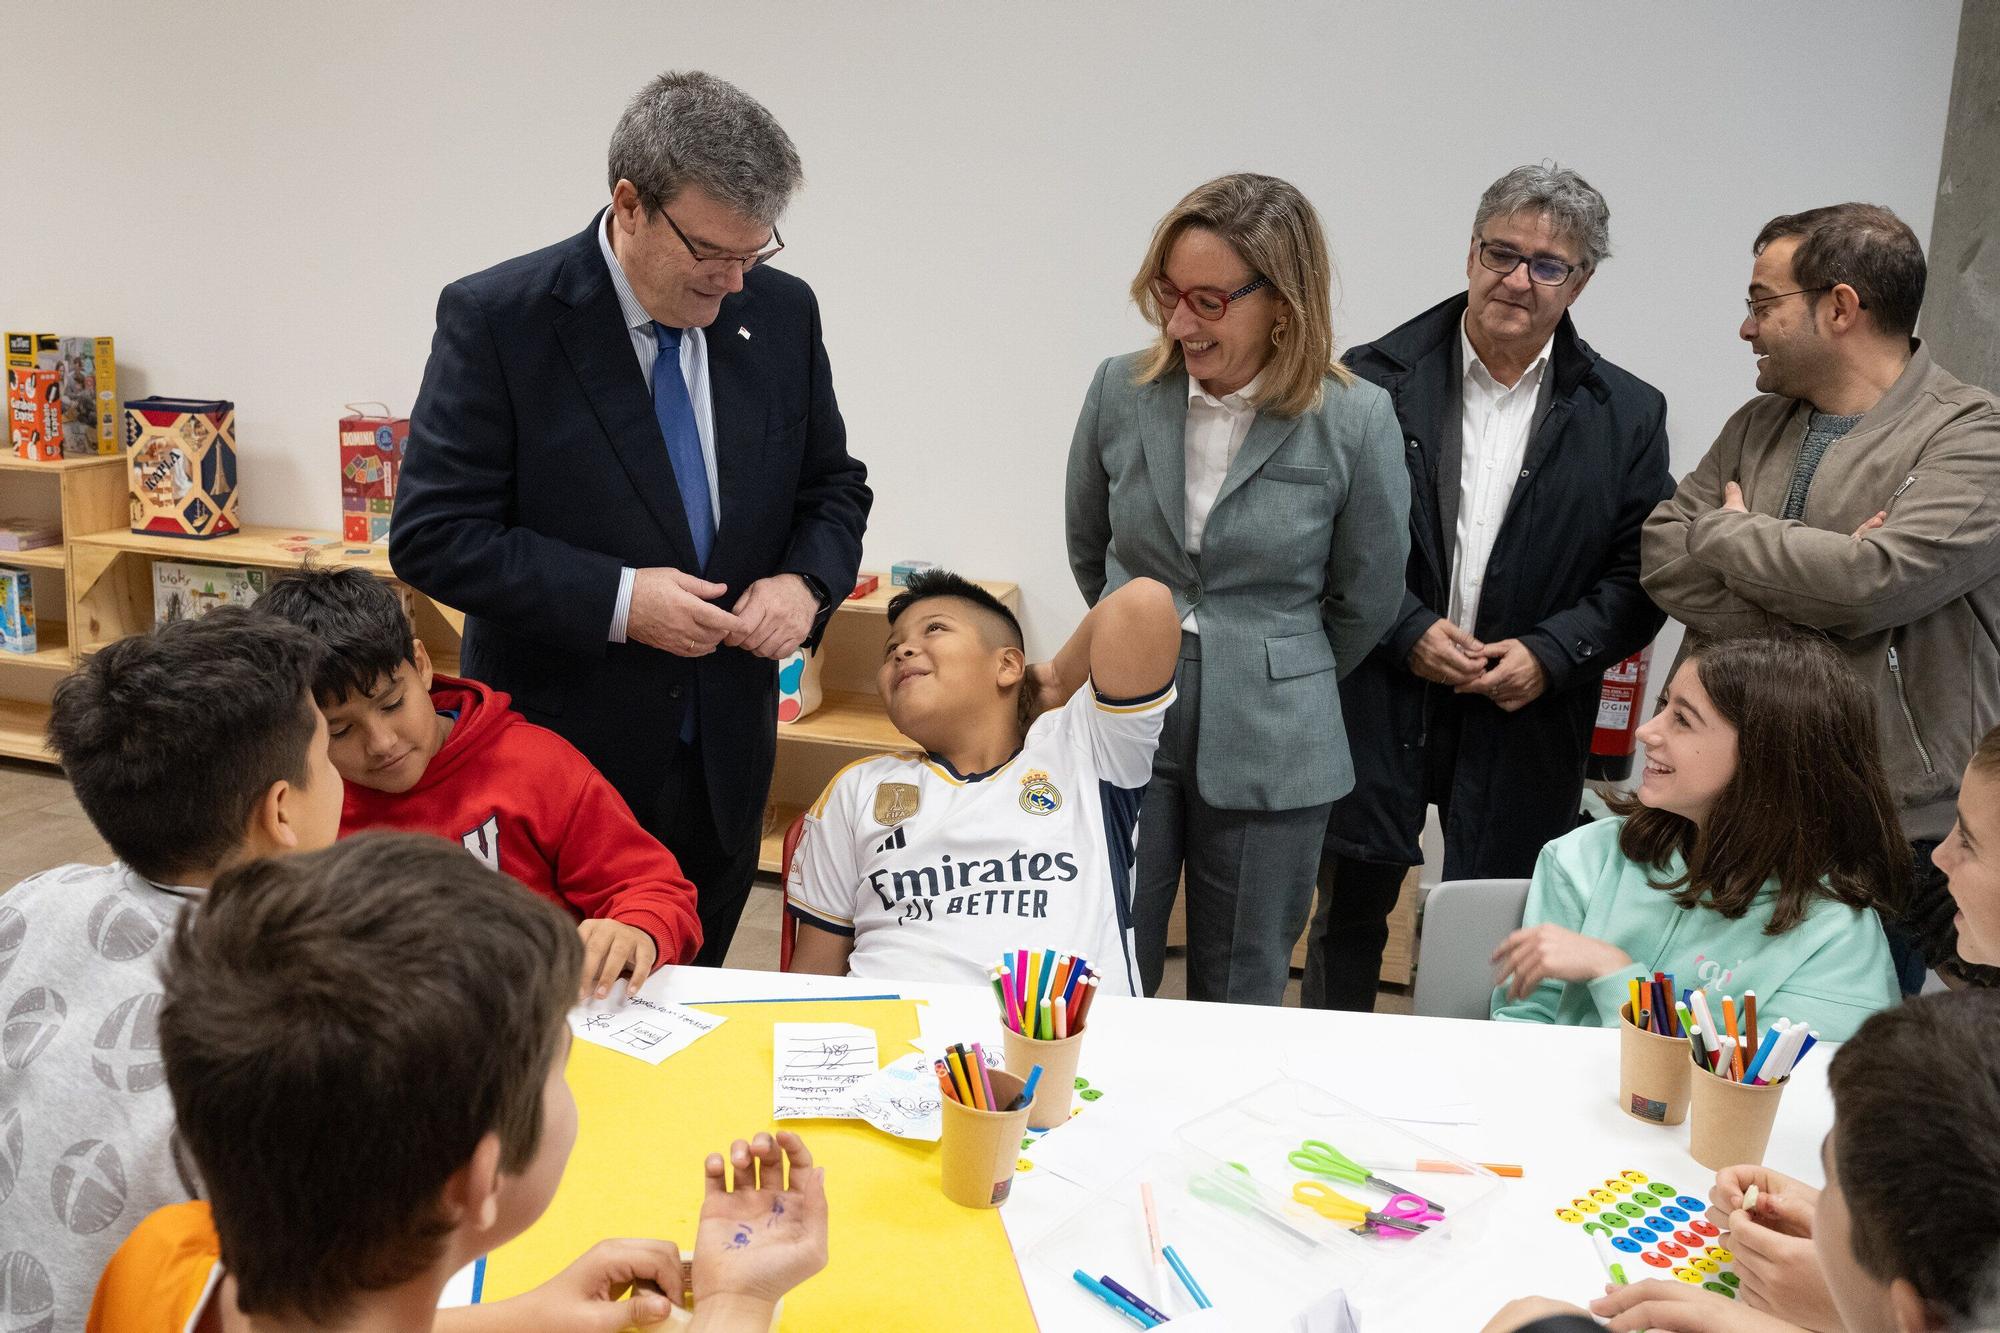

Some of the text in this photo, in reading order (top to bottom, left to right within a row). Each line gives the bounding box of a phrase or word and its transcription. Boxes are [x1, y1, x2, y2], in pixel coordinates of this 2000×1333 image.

[342, 431, 375, 446] DOMINO
[145, 451, 181, 491] KAPLA
[885, 810, 905, 819] FIFA
[868, 849, 1079, 911] Emirates
[947, 889, 1048, 918] BETTER
